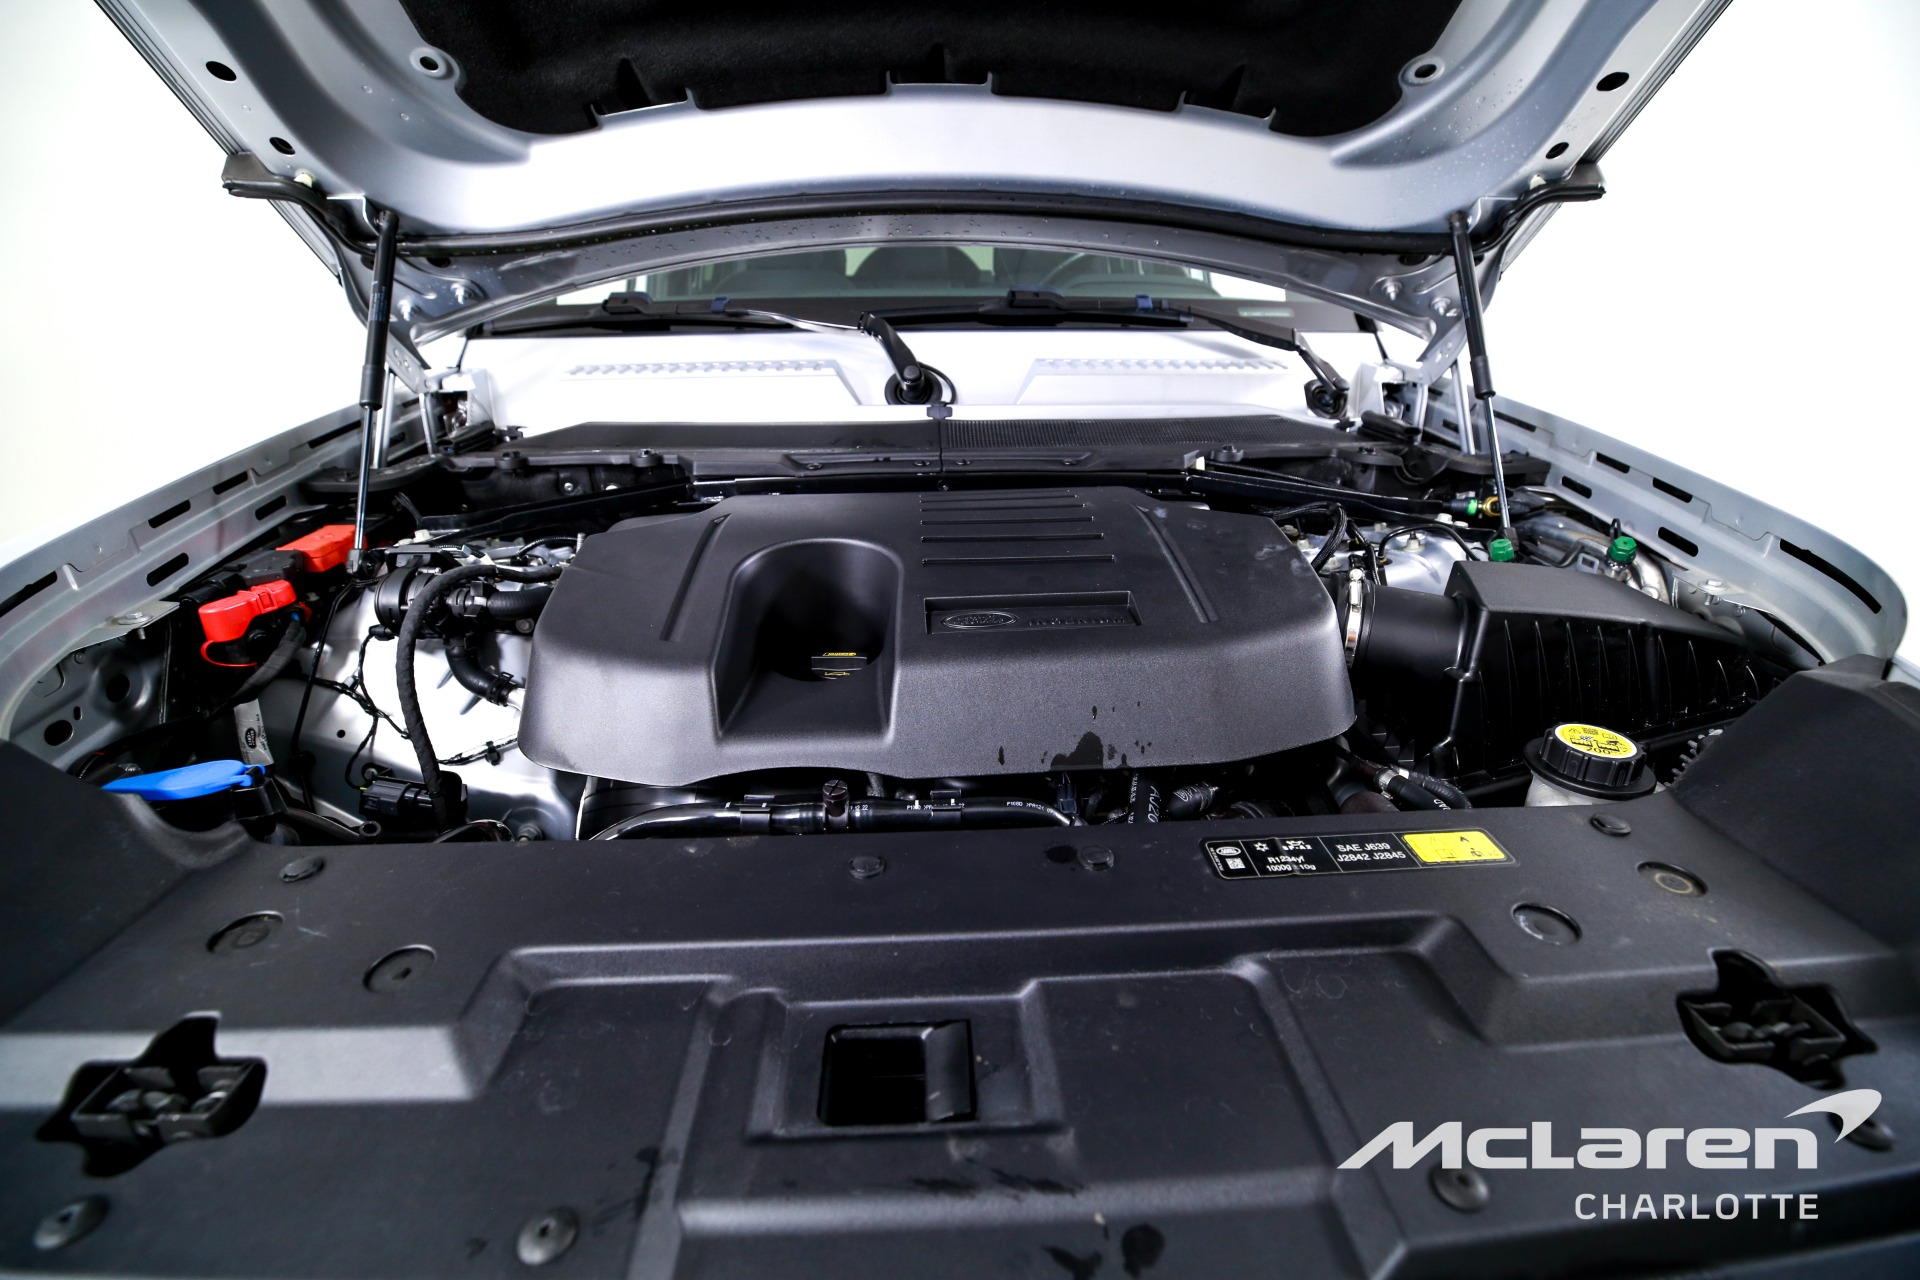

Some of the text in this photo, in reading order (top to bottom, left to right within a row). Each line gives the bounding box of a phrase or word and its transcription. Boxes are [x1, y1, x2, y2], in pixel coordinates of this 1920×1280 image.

[1337, 842, 1391, 852] SAE J639
[1267, 855, 1306, 864] R1234yf
[1337, 851, 1406, 862] J2842 J2845
